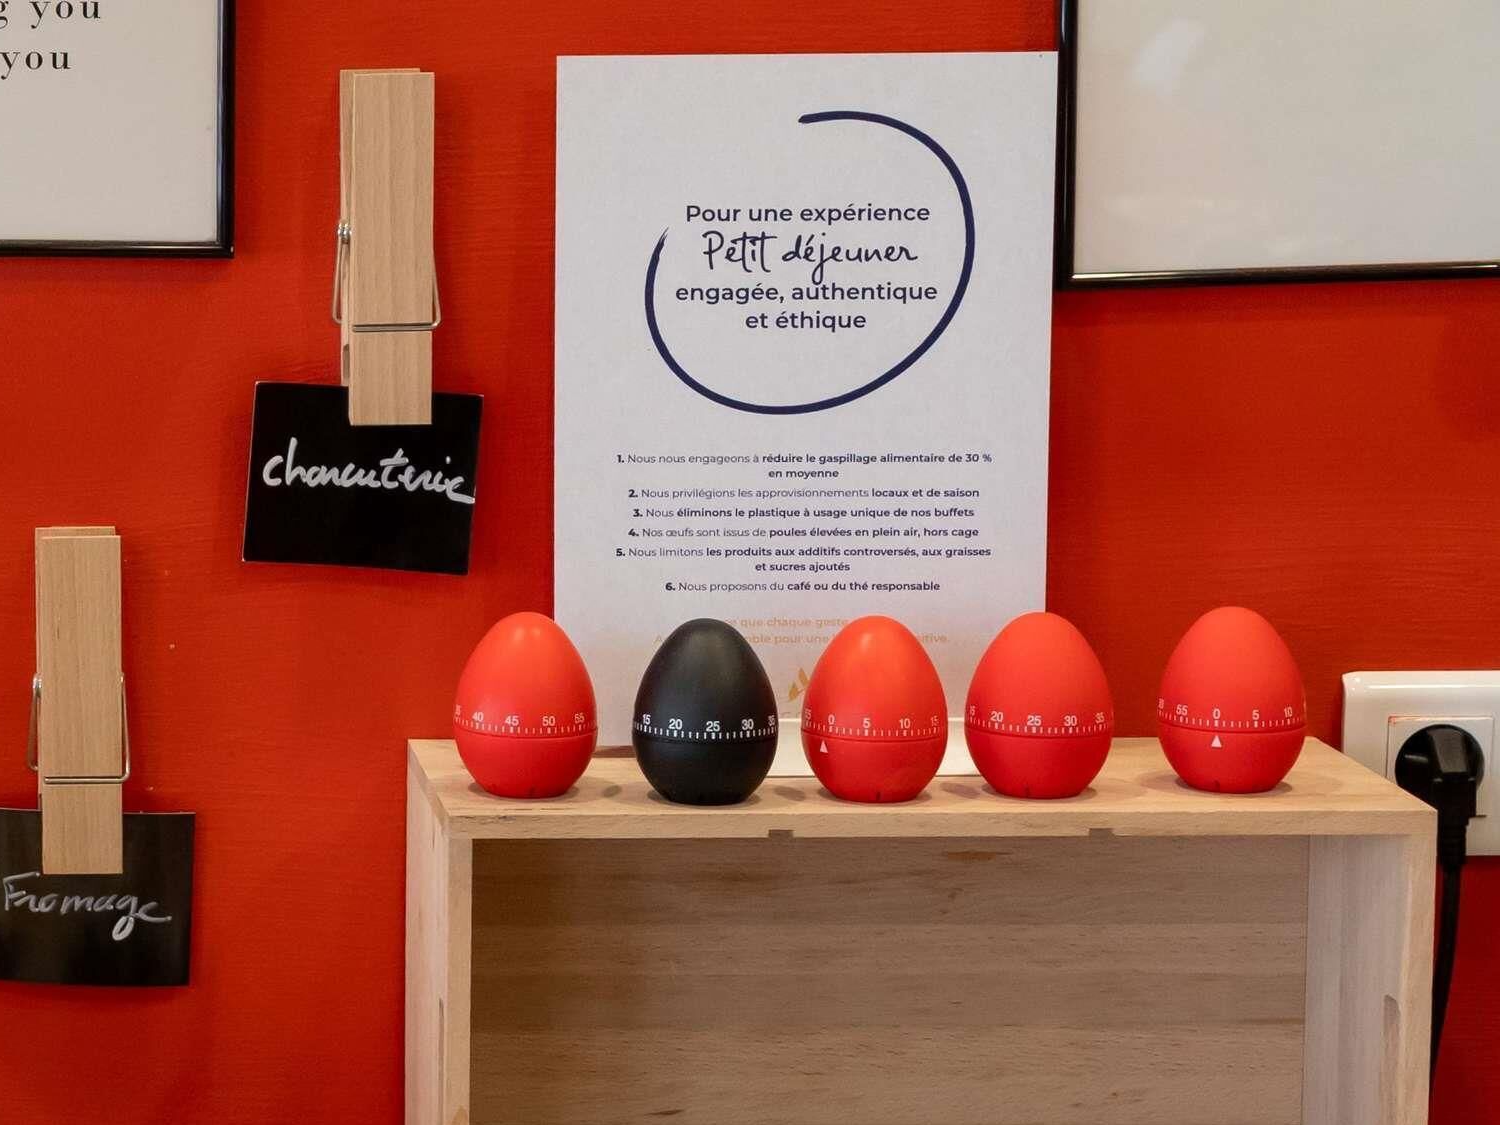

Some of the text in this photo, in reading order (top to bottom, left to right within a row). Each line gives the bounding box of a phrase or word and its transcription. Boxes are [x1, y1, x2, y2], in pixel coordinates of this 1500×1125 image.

[29, 0, 101, 29] you
[0, 51, 71, 80] you
[686, 202, 931, 226] Pour une expérience
[702, 230, 918, 285] Petit déjeuner
[675, 282, 938, 304] engagée, authentique
[745, 309, 867, 332] et éthique
[616, 452, 993, 465] 1. Nous nous engageons à réduire le gaspillage alimentaire de 30 %
[768, 470, 840, 480] en moyenne
[628, 488, 980, 500] 2. Nous privilégions les approvisionnements locaux et de saison
[632, 507, 975, 519] 3. Nous éliminons le plastique à usage unique de nos buffets
[628, 527, 980, 538] 4. Nos œufs sont issus de poules élevées en plein air, hors cage
[615, 547, 992, 558] 5. Nous limitons les produits aux additifs controversés, aux graisses
[754, 562, 851, 573] et sucres ajoutés
[664, 581, 941, 593] 6. Nous proposons du café ou du thé responsable
[505, 715, 519, 726] 45
[668, 718, 754, 732] 20 25 30
[899, 718, 911, 730] 10
[991, 710, 1077, 727] 20 25 30
[2, 871, 173, 942] Fromage
